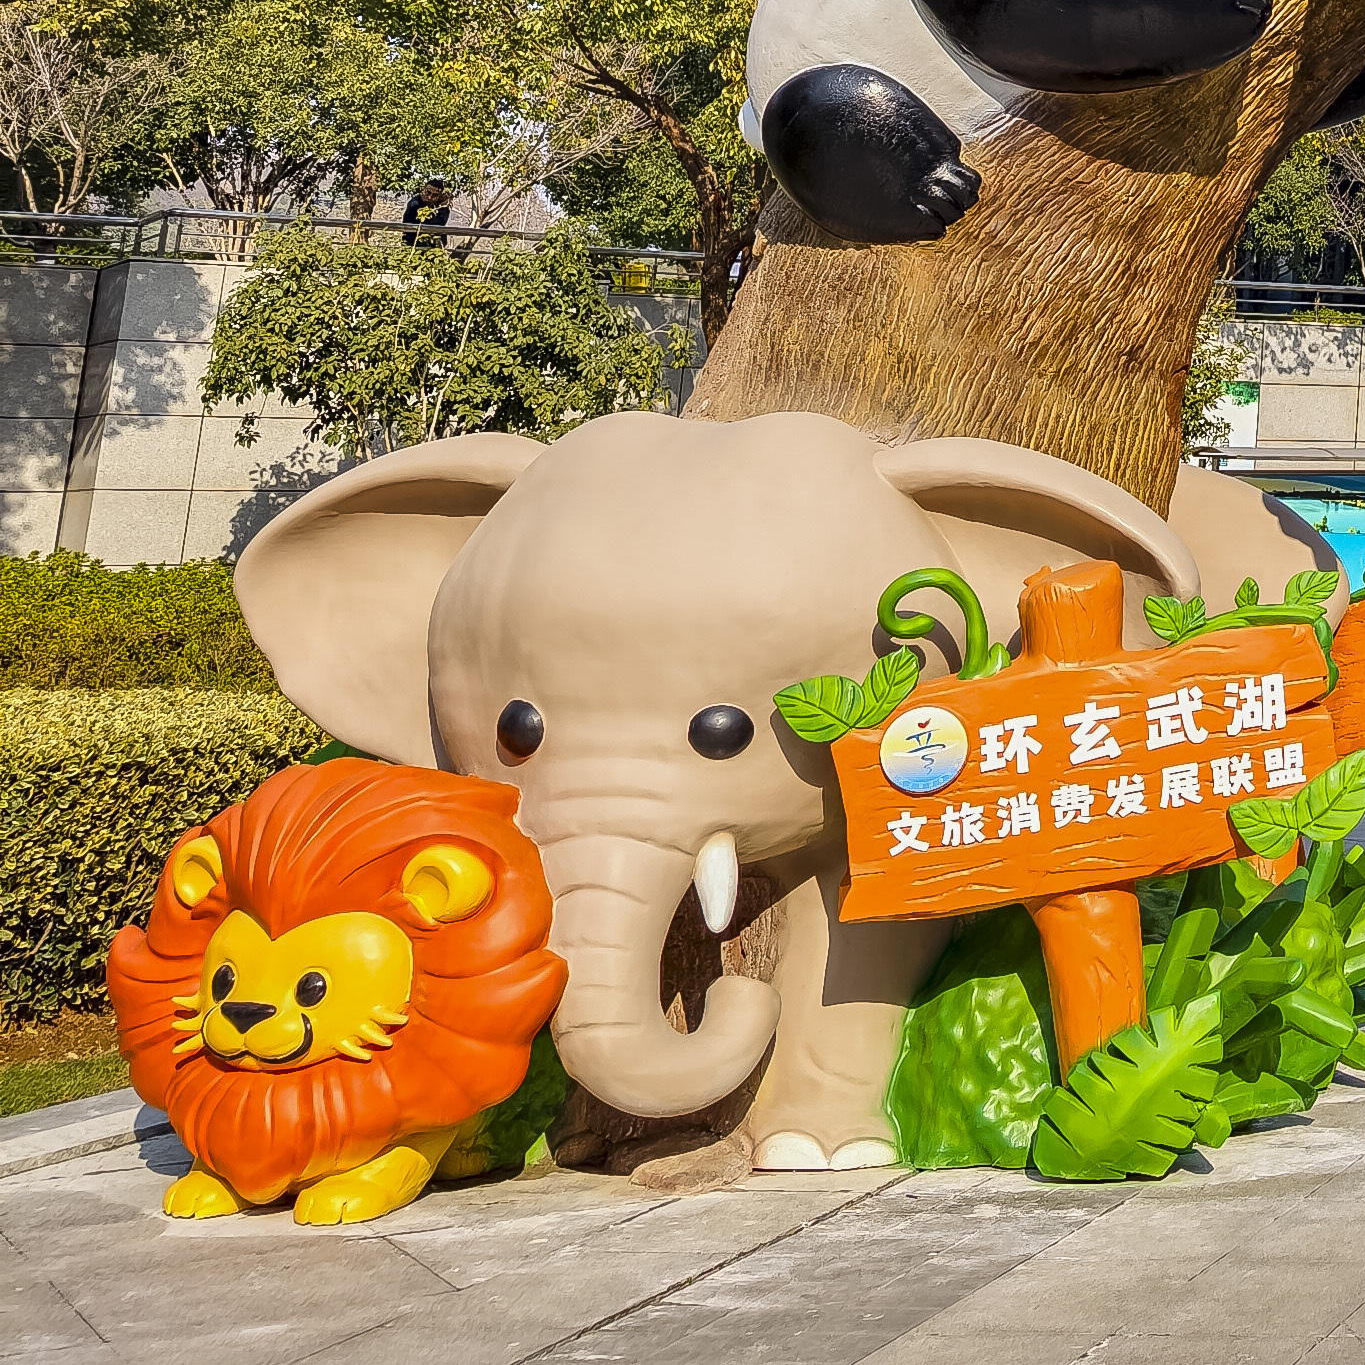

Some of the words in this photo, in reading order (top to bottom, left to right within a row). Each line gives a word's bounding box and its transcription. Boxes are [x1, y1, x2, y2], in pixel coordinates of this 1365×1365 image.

[979, 673, 1287, 774] 环玄武湖
[887, 742, 1307, 857] 文旅消费发展联盟
